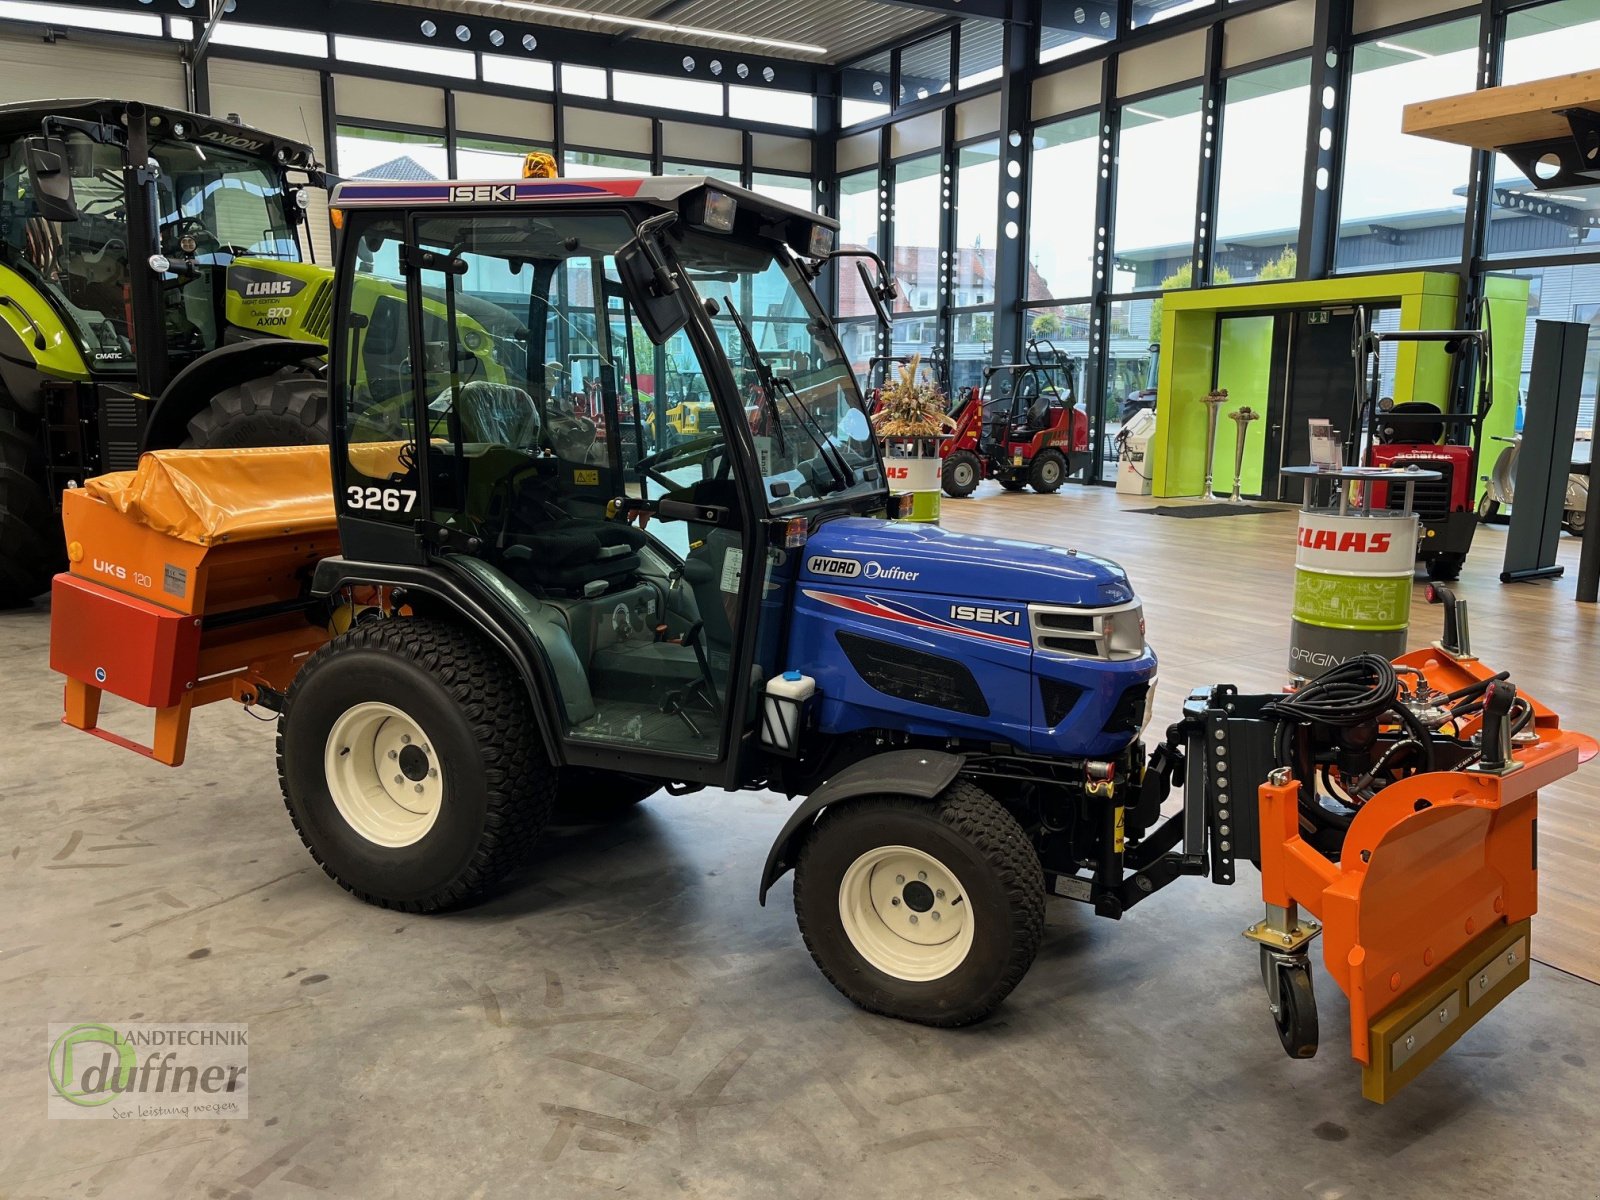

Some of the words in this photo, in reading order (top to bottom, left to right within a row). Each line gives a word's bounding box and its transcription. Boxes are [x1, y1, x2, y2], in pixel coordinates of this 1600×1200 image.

[199, 131, 264, 150] AXION
[449, 185, 516, 202] ISEKI
[245, 280, 292, 296] CLAAS
[256, 317, 287, 326] AXION
[267, 307, 292, 317] 870
[346, 485, 417, 513] 3267
[1297, 526, 1392, 553] CLAAS
[93, 558, 127, 579] UKS
[133, 571, 152, 588] 120
[812, 558, 856, 575] HYDRO
[863, 560, 920, 581] Duffner
[950, 605, 1020, 626] ISEKI
[1290, 646, 1346, 667] ORIGIN
